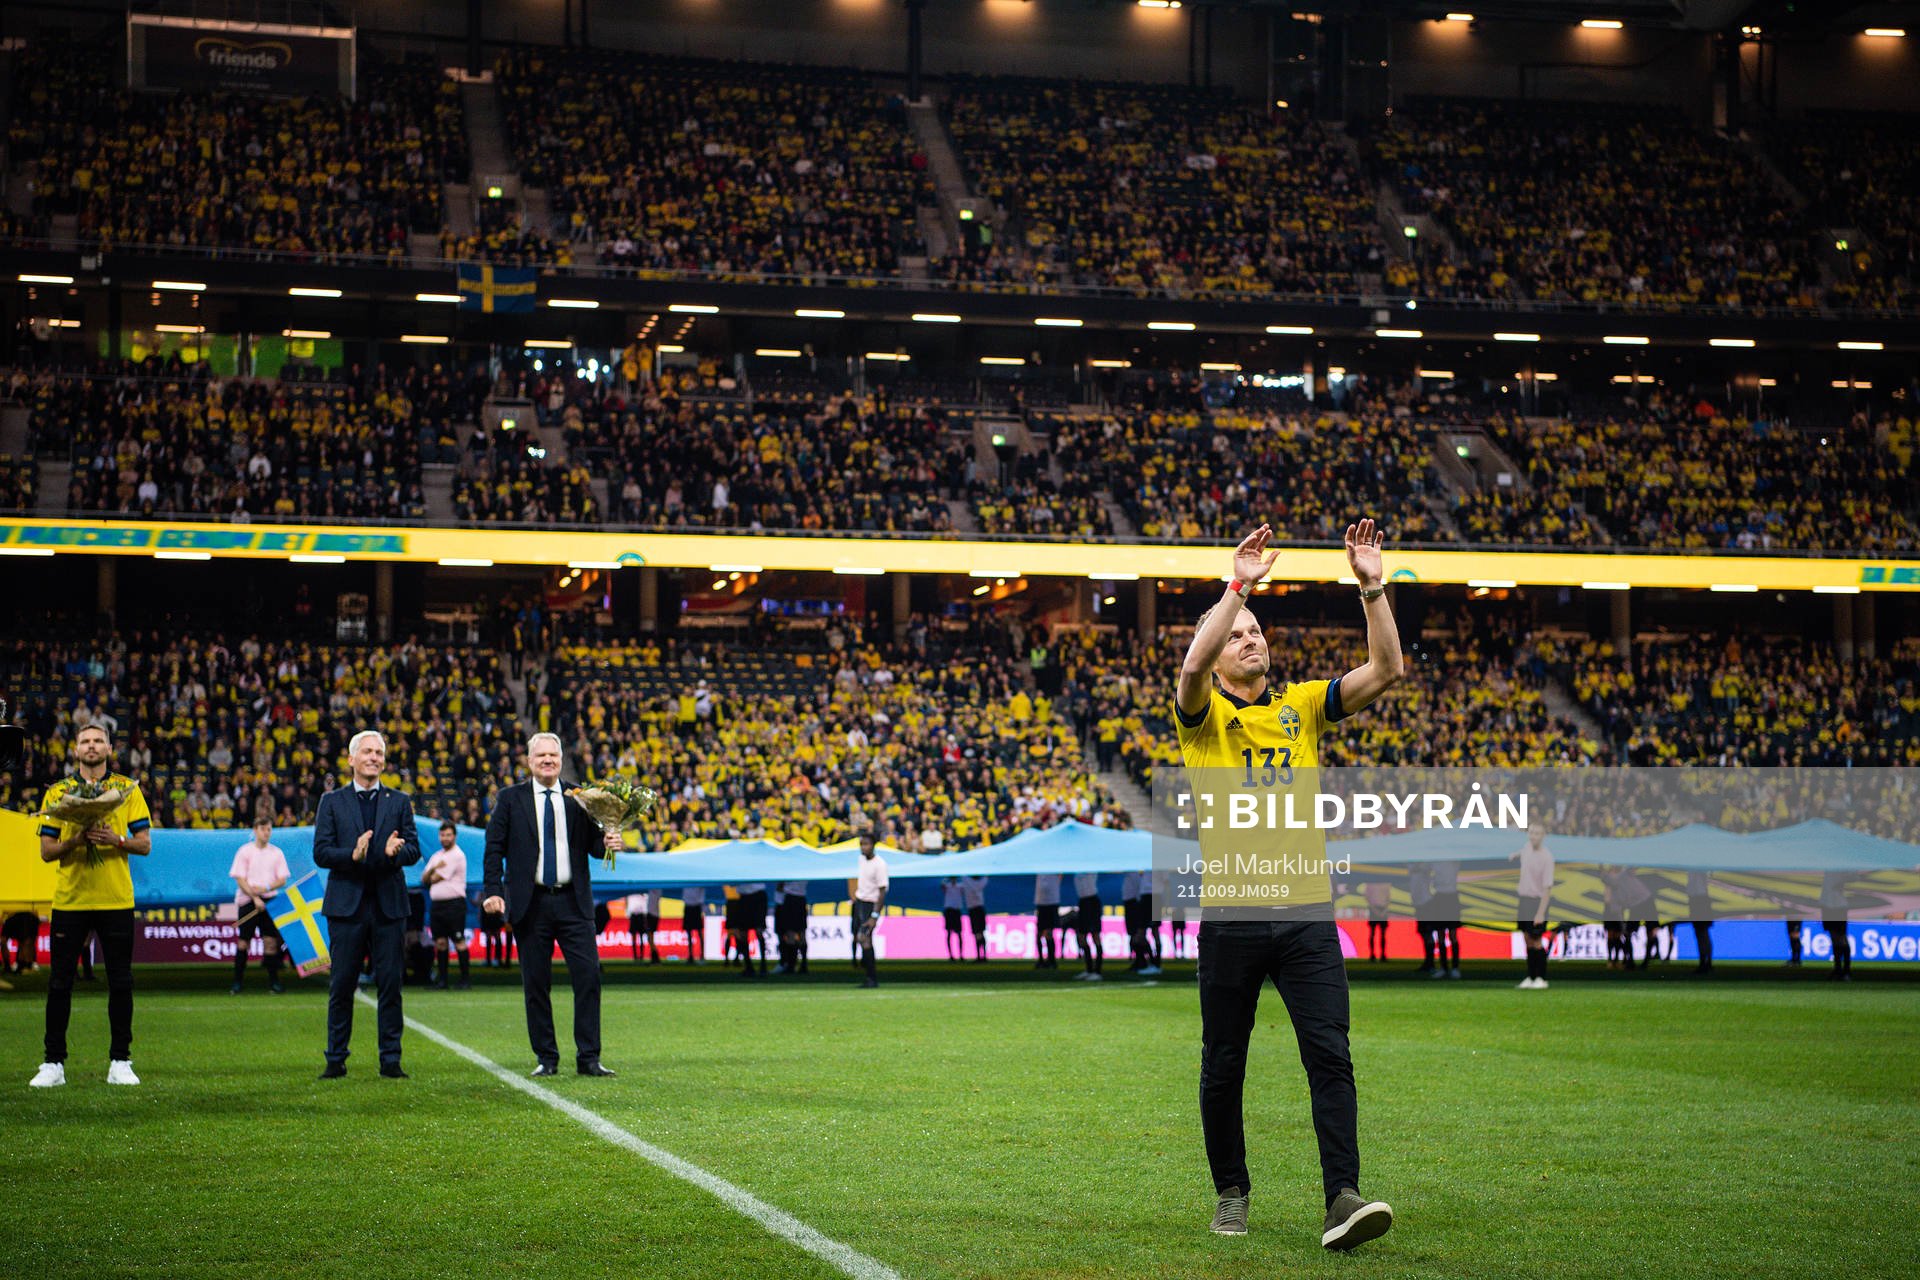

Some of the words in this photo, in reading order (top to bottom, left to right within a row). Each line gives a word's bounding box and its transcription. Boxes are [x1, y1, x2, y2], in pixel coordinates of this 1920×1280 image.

[209, 47, 277, 69] friends
[1241, 747, 1294, 788] 133
[144, 926, 178, 939] FIFA
[179, 925, 233, 939] WORLD
